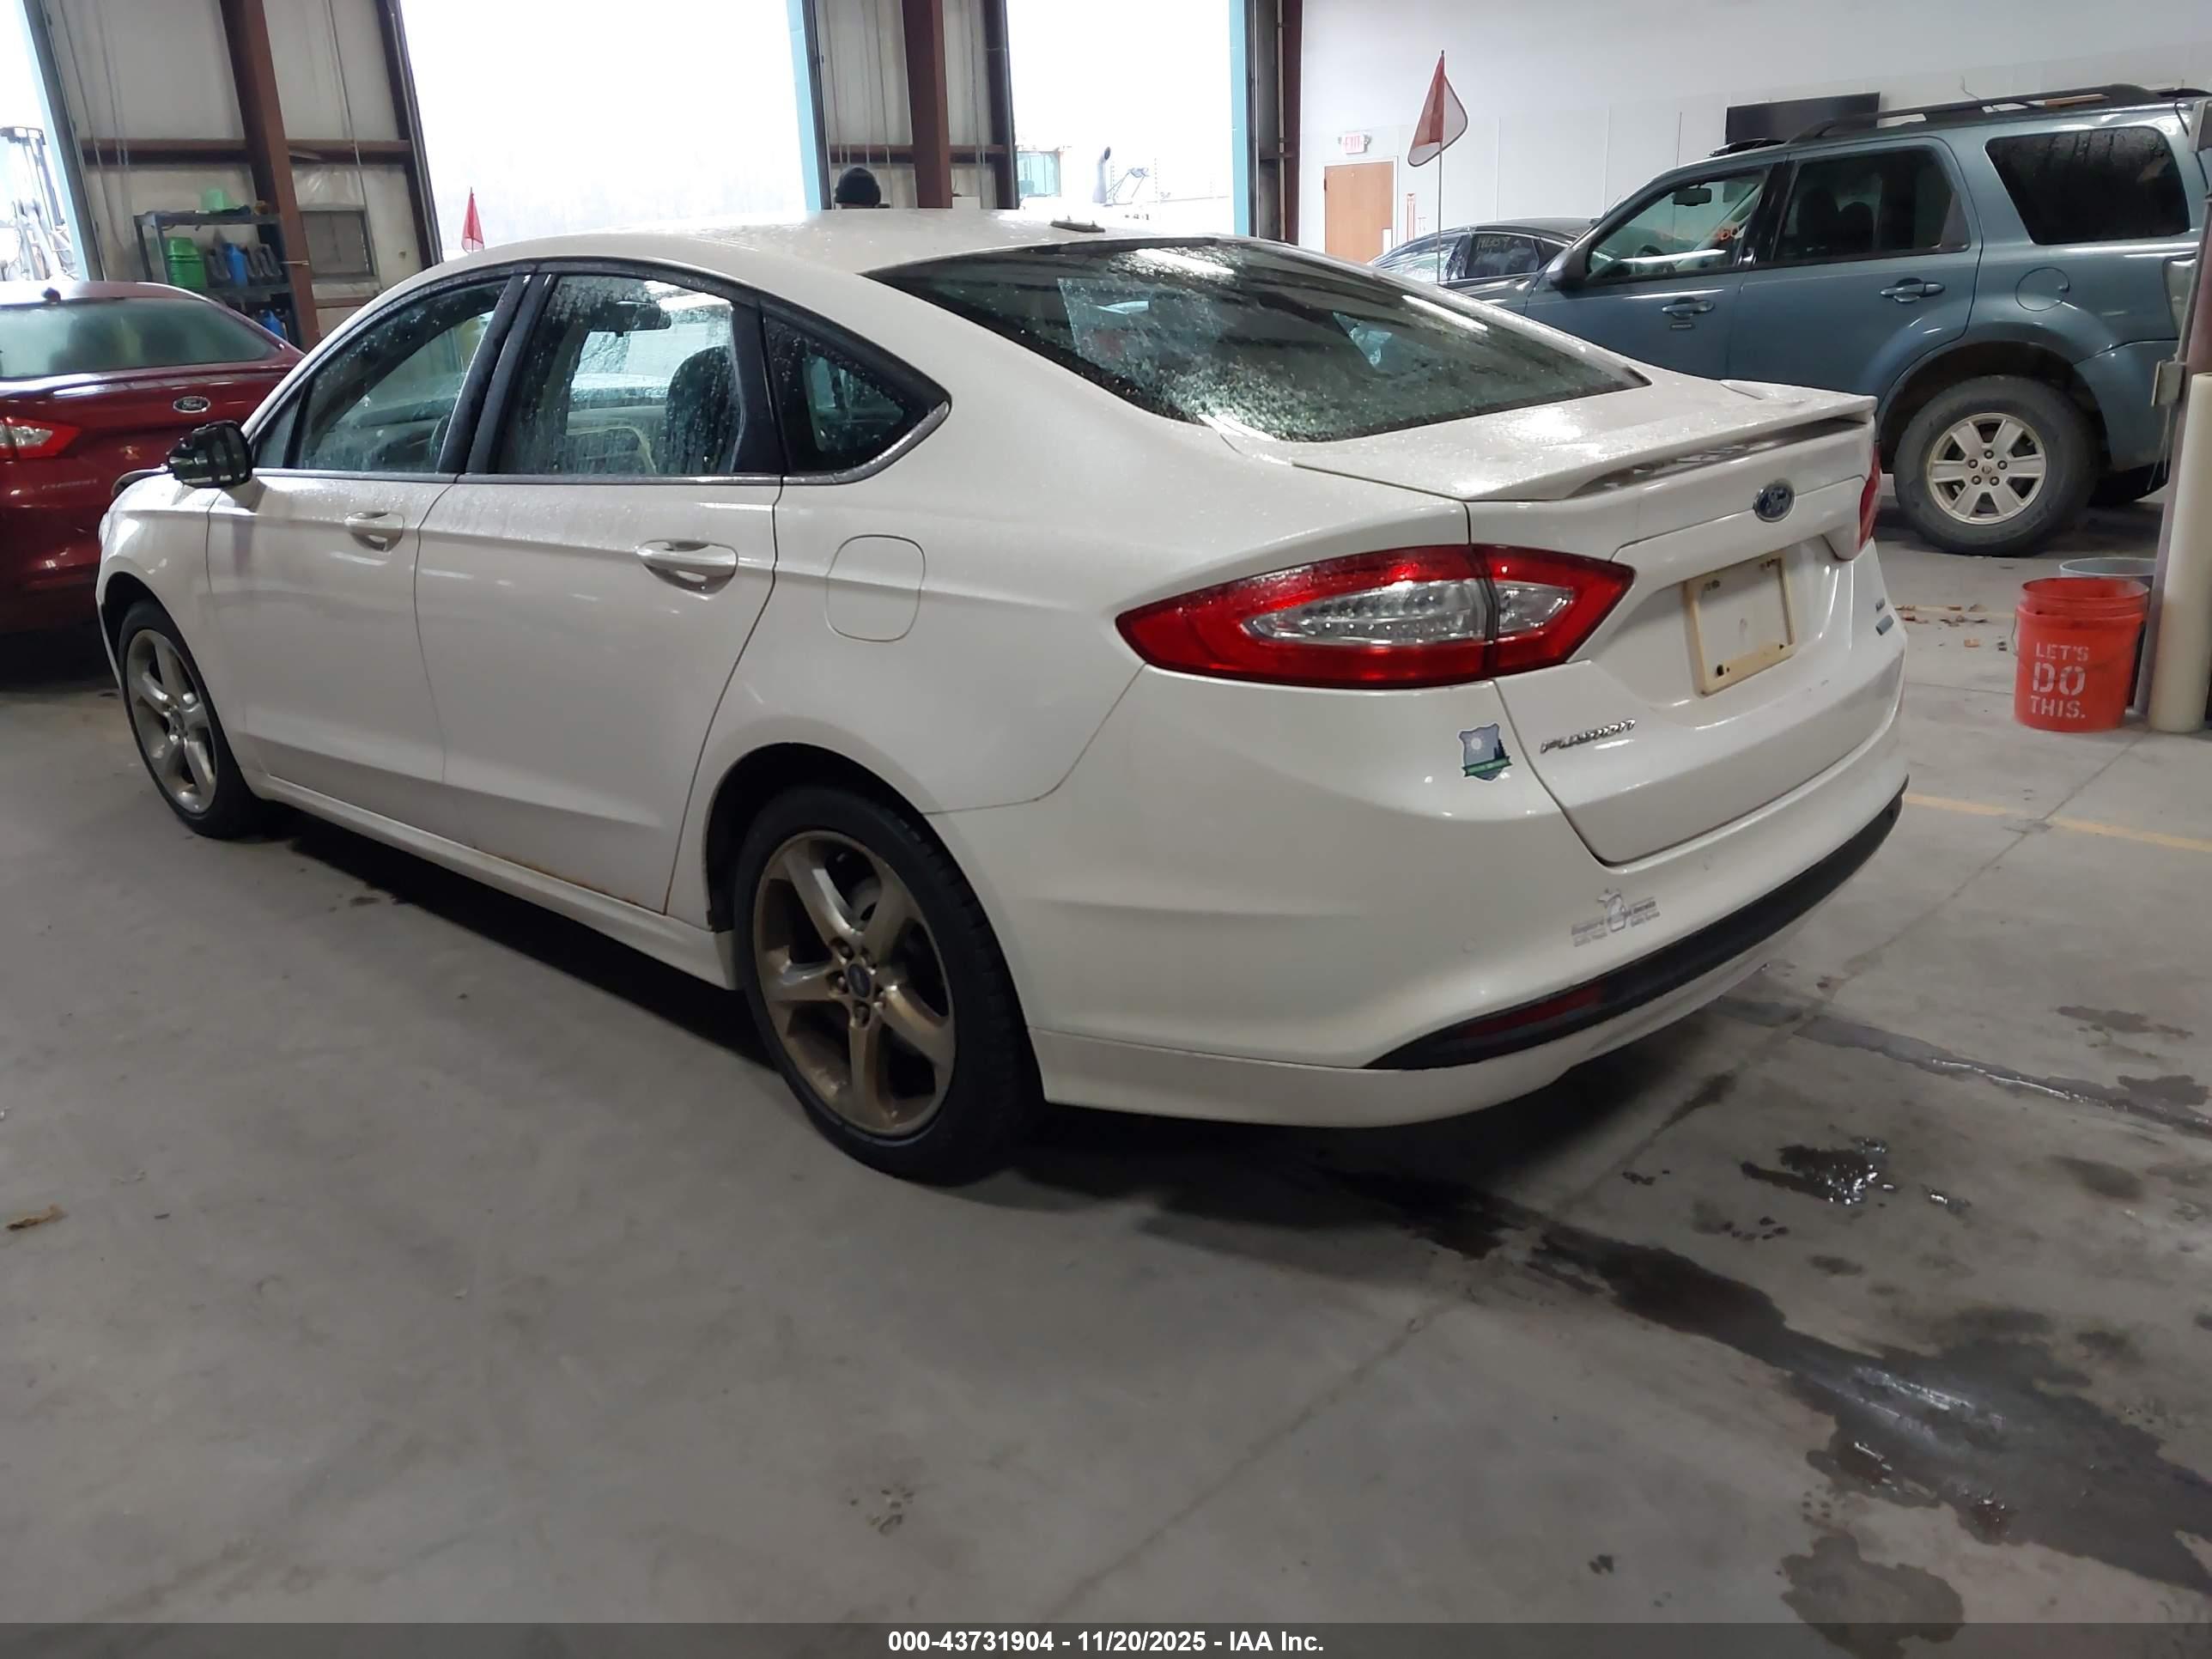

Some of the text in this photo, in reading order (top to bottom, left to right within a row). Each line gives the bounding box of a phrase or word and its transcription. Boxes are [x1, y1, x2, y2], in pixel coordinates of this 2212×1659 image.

[2035, 641, 2089, 661] LET'S
[2033, 661, 2087, 696] DO
[2031, 695, 2087, 719] THIS.
